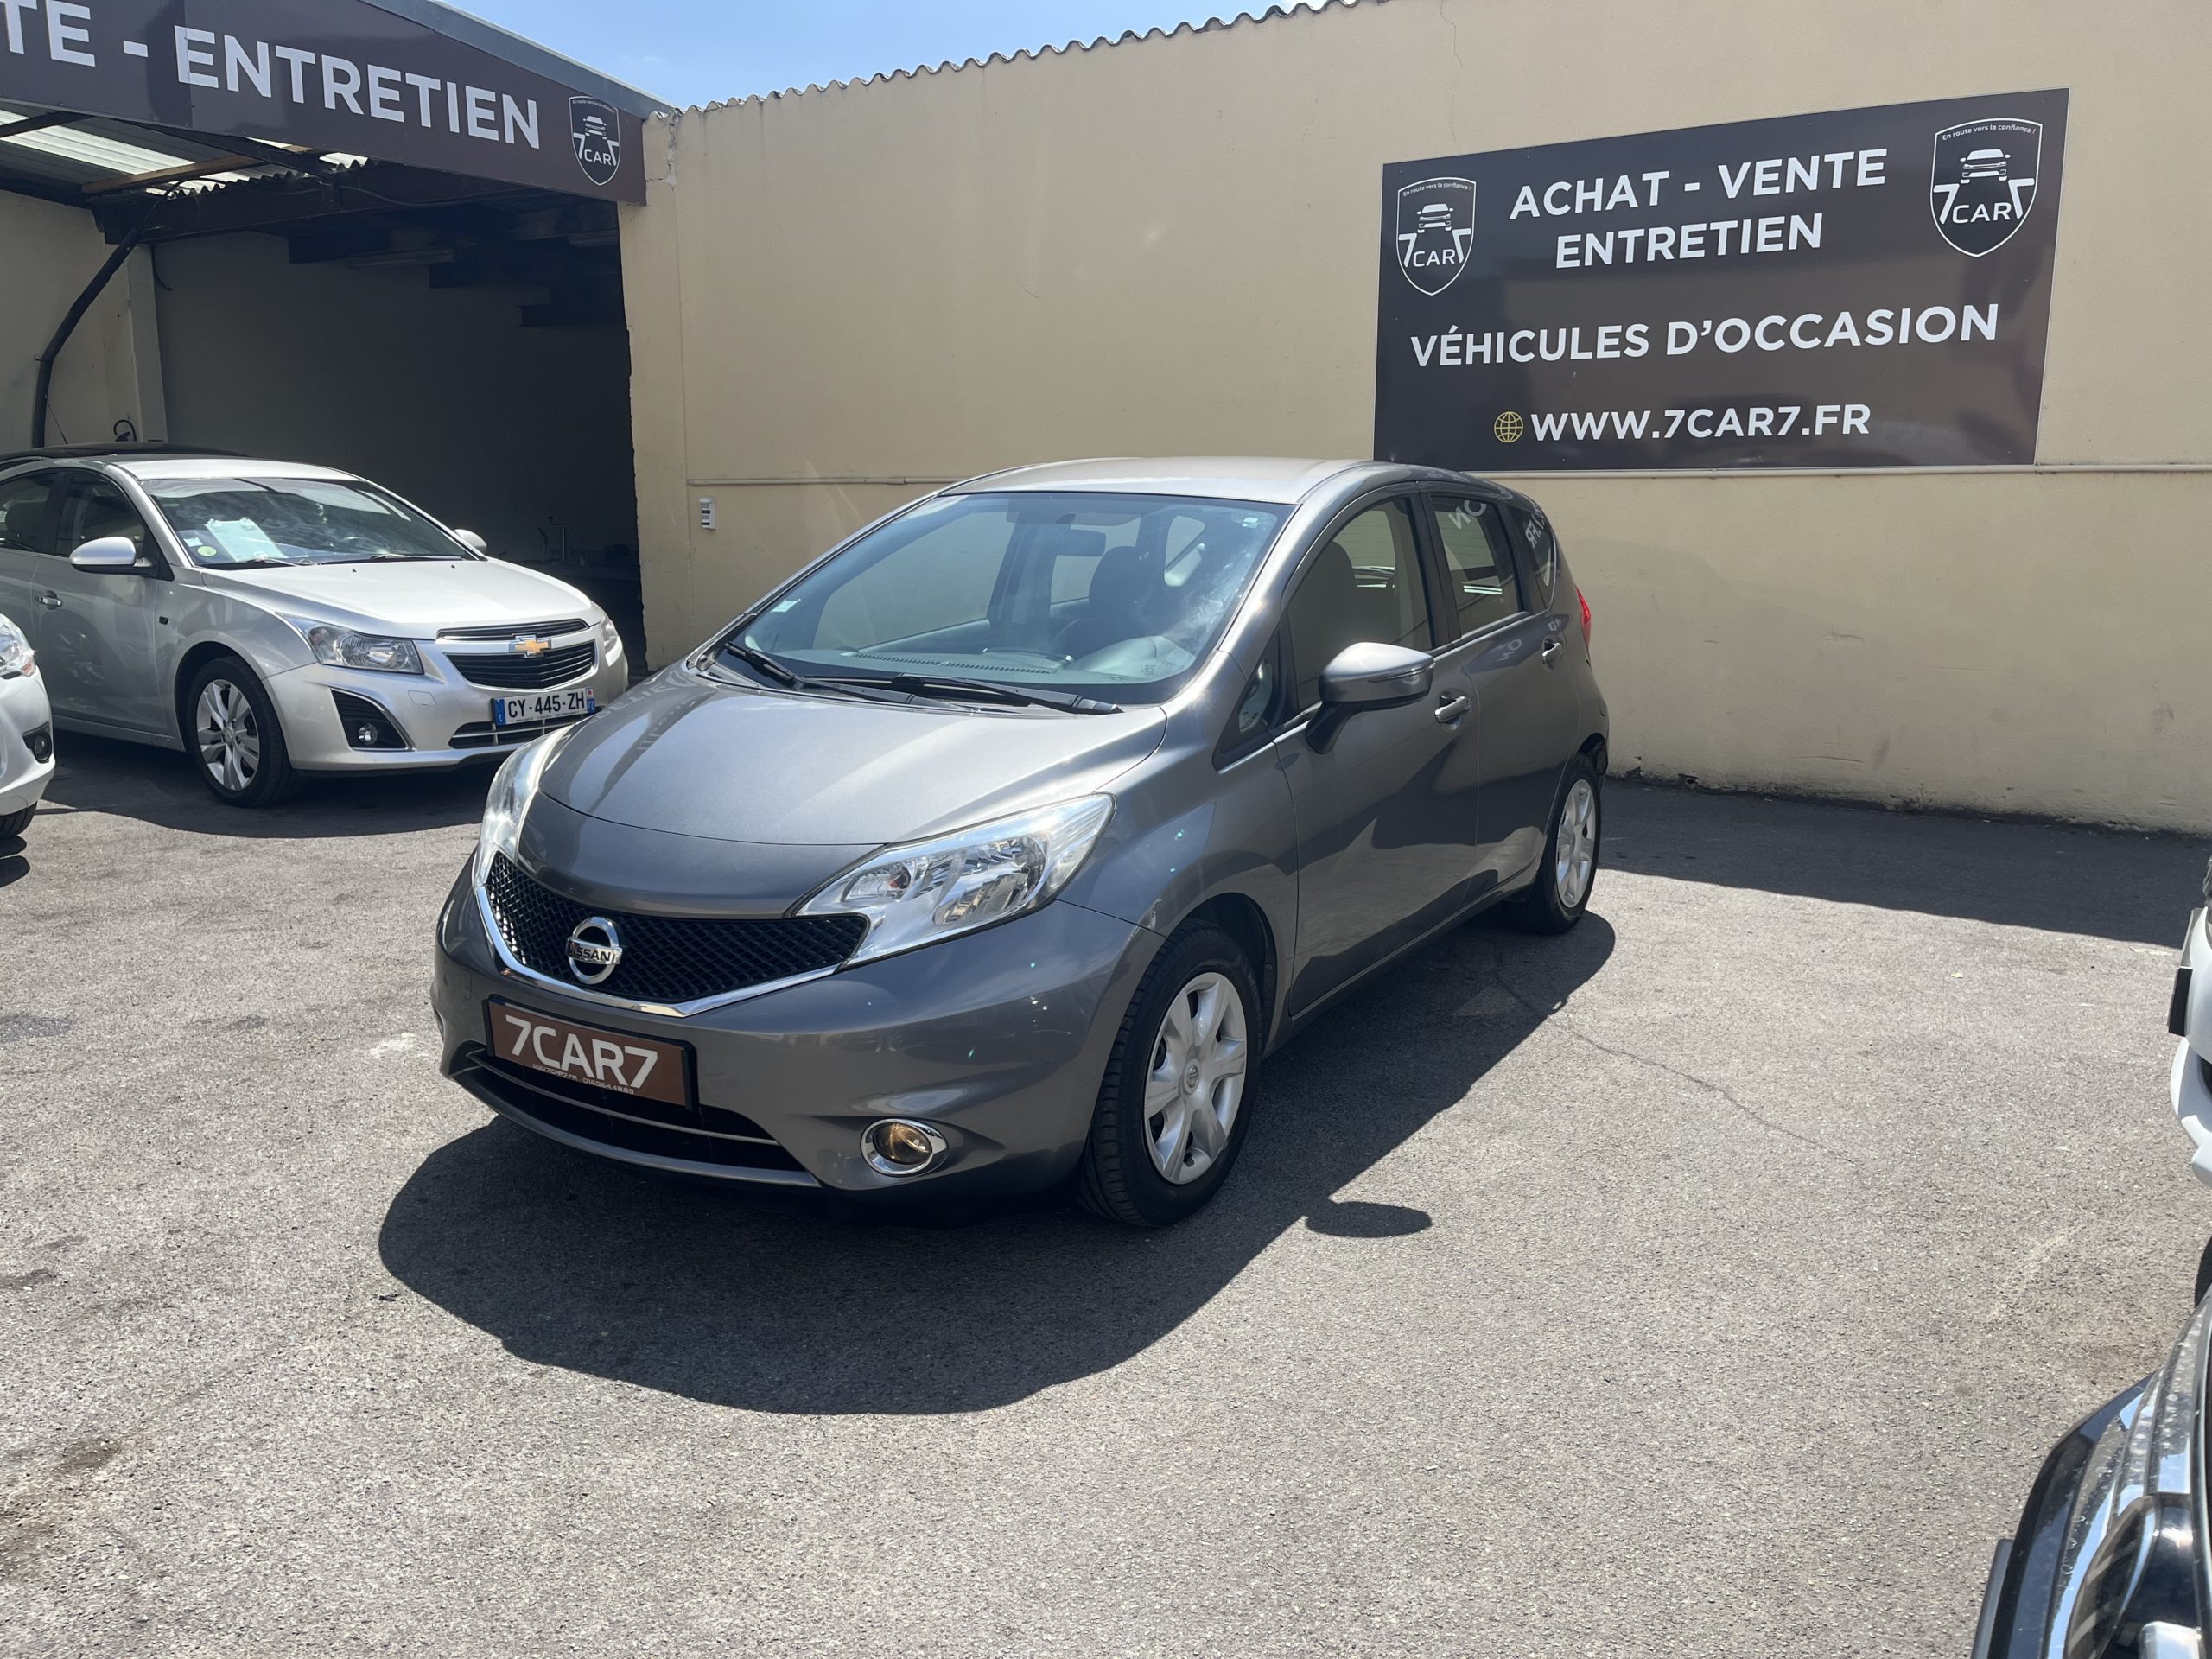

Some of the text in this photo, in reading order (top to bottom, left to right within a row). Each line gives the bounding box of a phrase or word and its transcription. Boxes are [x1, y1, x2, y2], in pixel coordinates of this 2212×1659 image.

[175, 25, 540, 149] ENTRETIEN
[1953, 128, 1972, 137] route
[1998, 124, 2031, 134] confiance
[1510, 171, 1669, 219] ACHAT
[1718, 149, 1888, 198] VENTE
[1557, 213, 1823, 268] ENTRETIEN
[1411, 303, 1998, 366] VÉHICULES D'OCCASION
[1531, 404, 1871, 441] WWW.7CAR7.FR
[508, 691, 585, 718] CY-445-ZH
[505, 1014, 658, 1089] 7CAR7
